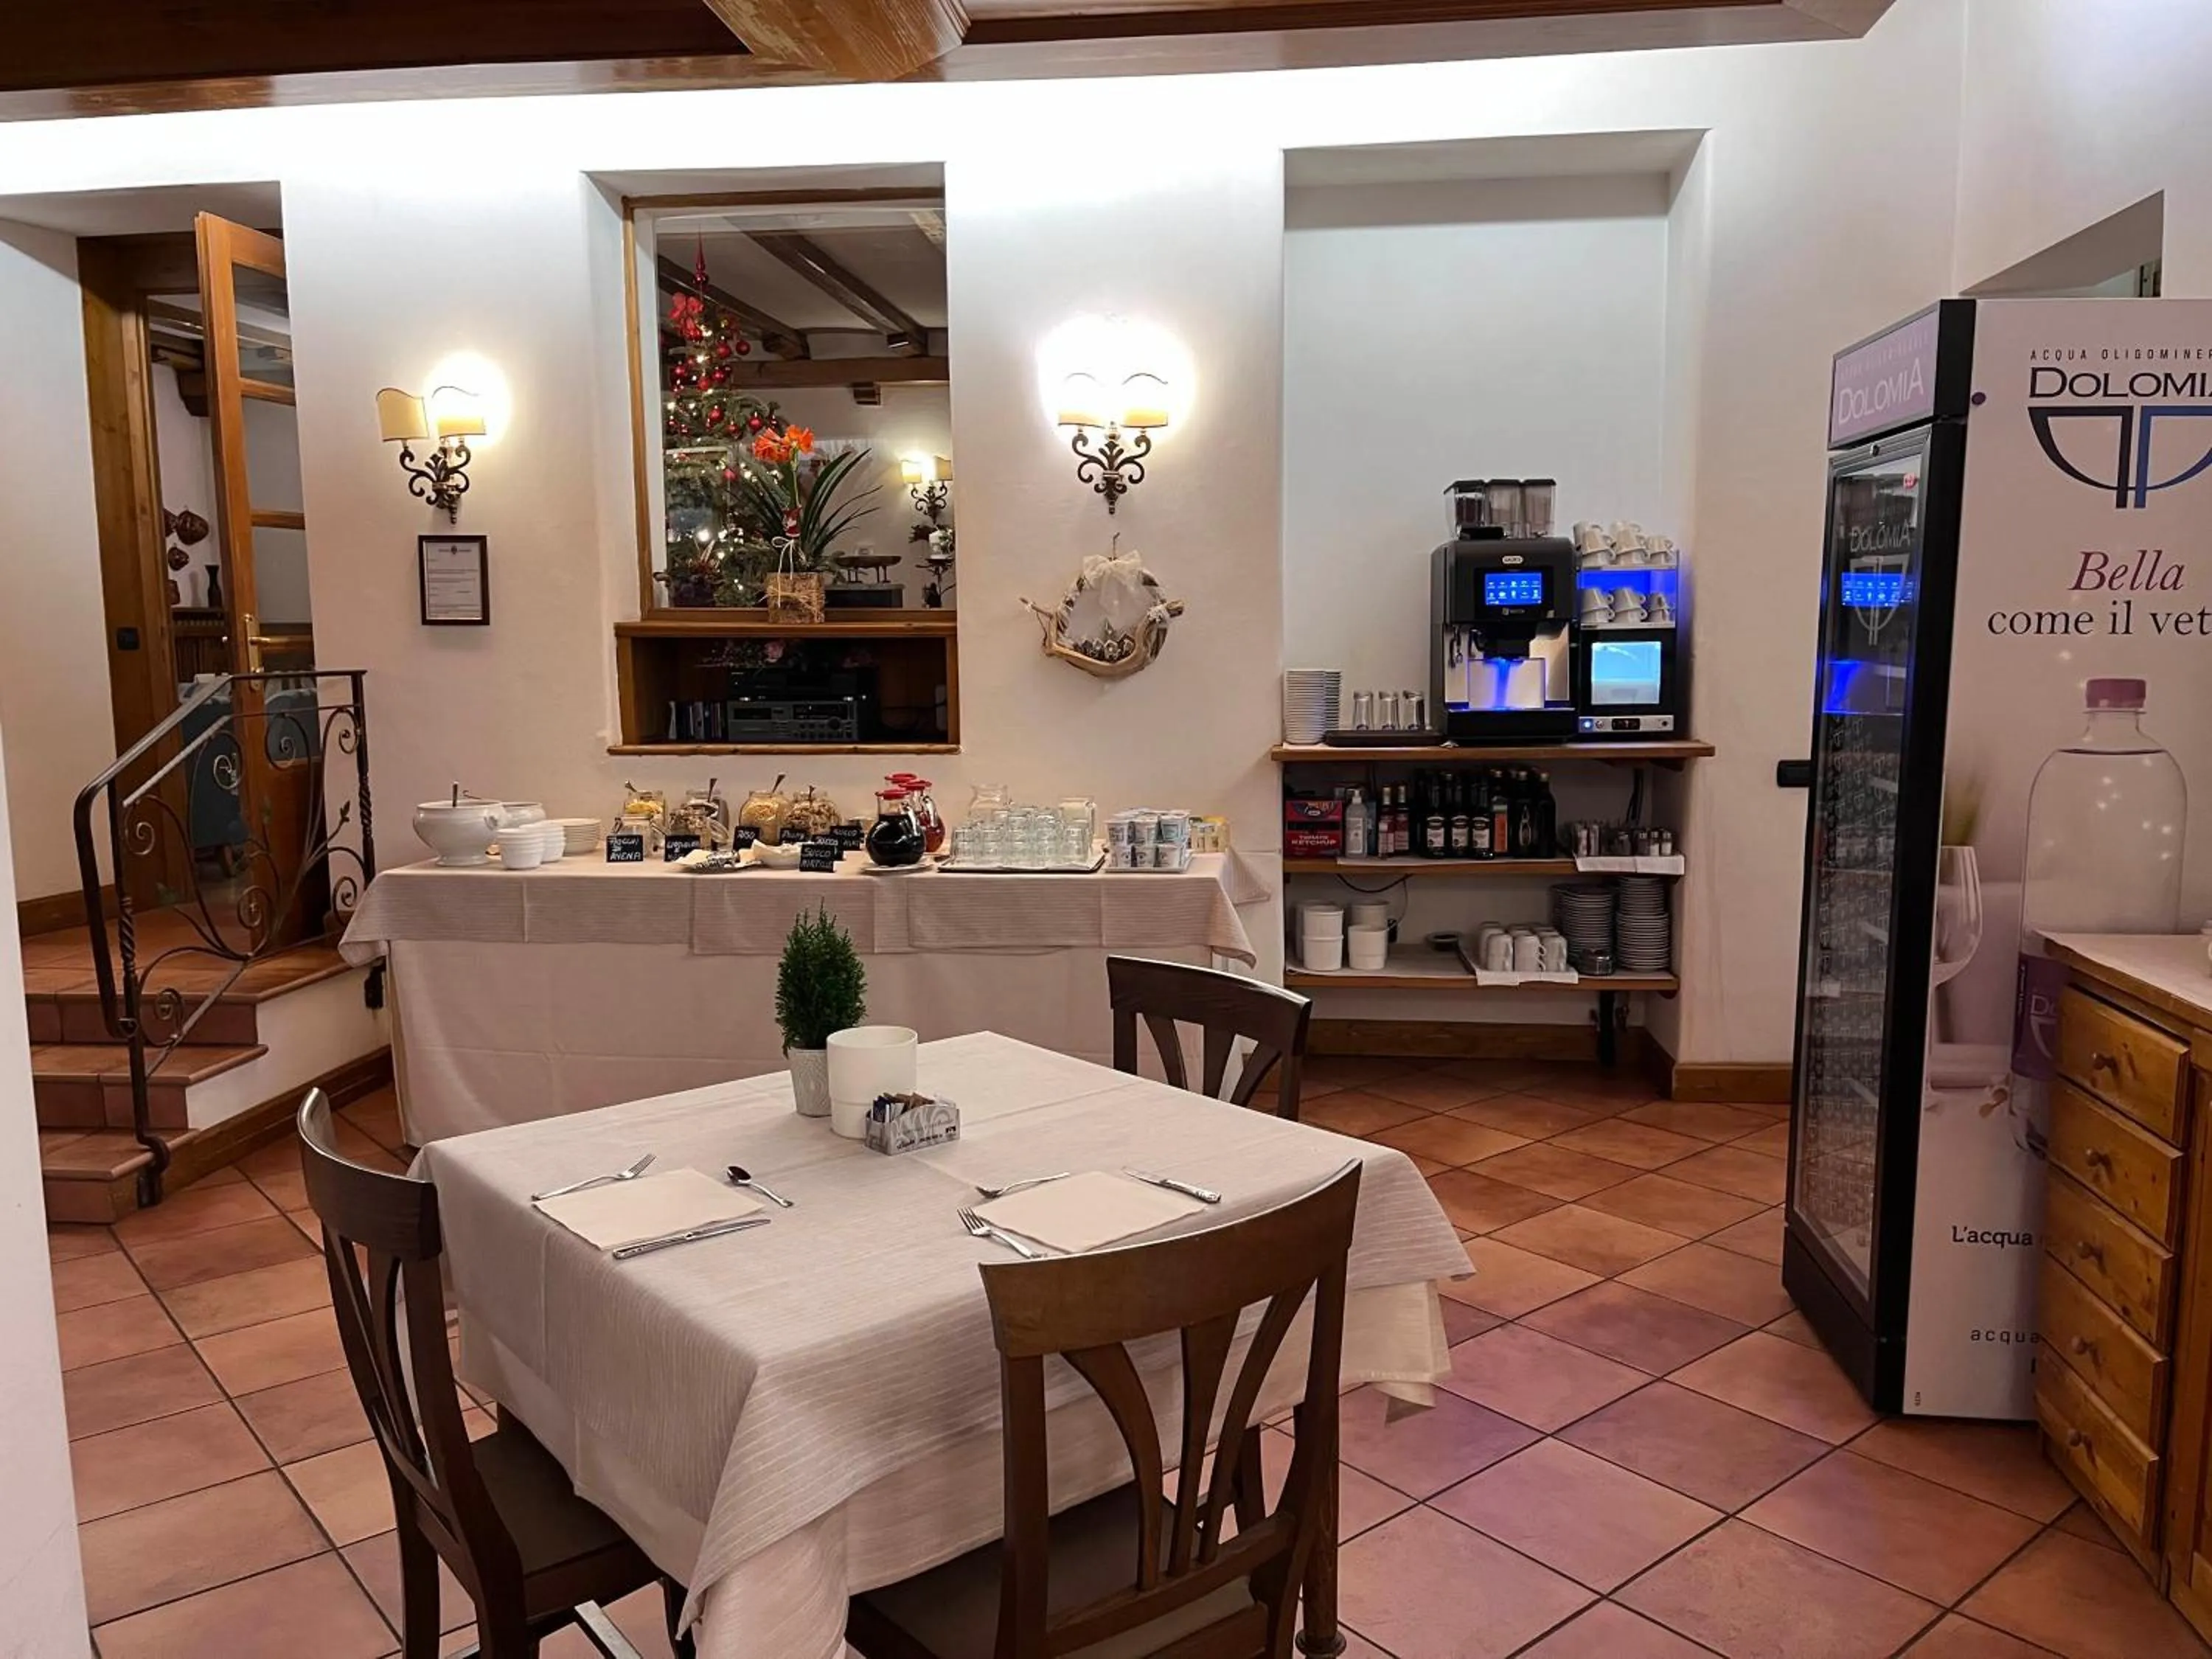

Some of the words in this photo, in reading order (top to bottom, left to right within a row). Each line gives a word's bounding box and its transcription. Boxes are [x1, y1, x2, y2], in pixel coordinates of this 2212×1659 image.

[2031, 349, 2087, 361] ACQUA
[2029, 366, 2212, 398] DOLOMI
[2067, 549, 2185, 591] Bella
[1988, 611, 2094, 635] come
[2107, 599, 2133, 635] il
[1952, 1225, 2034, 1248] L'acqua
